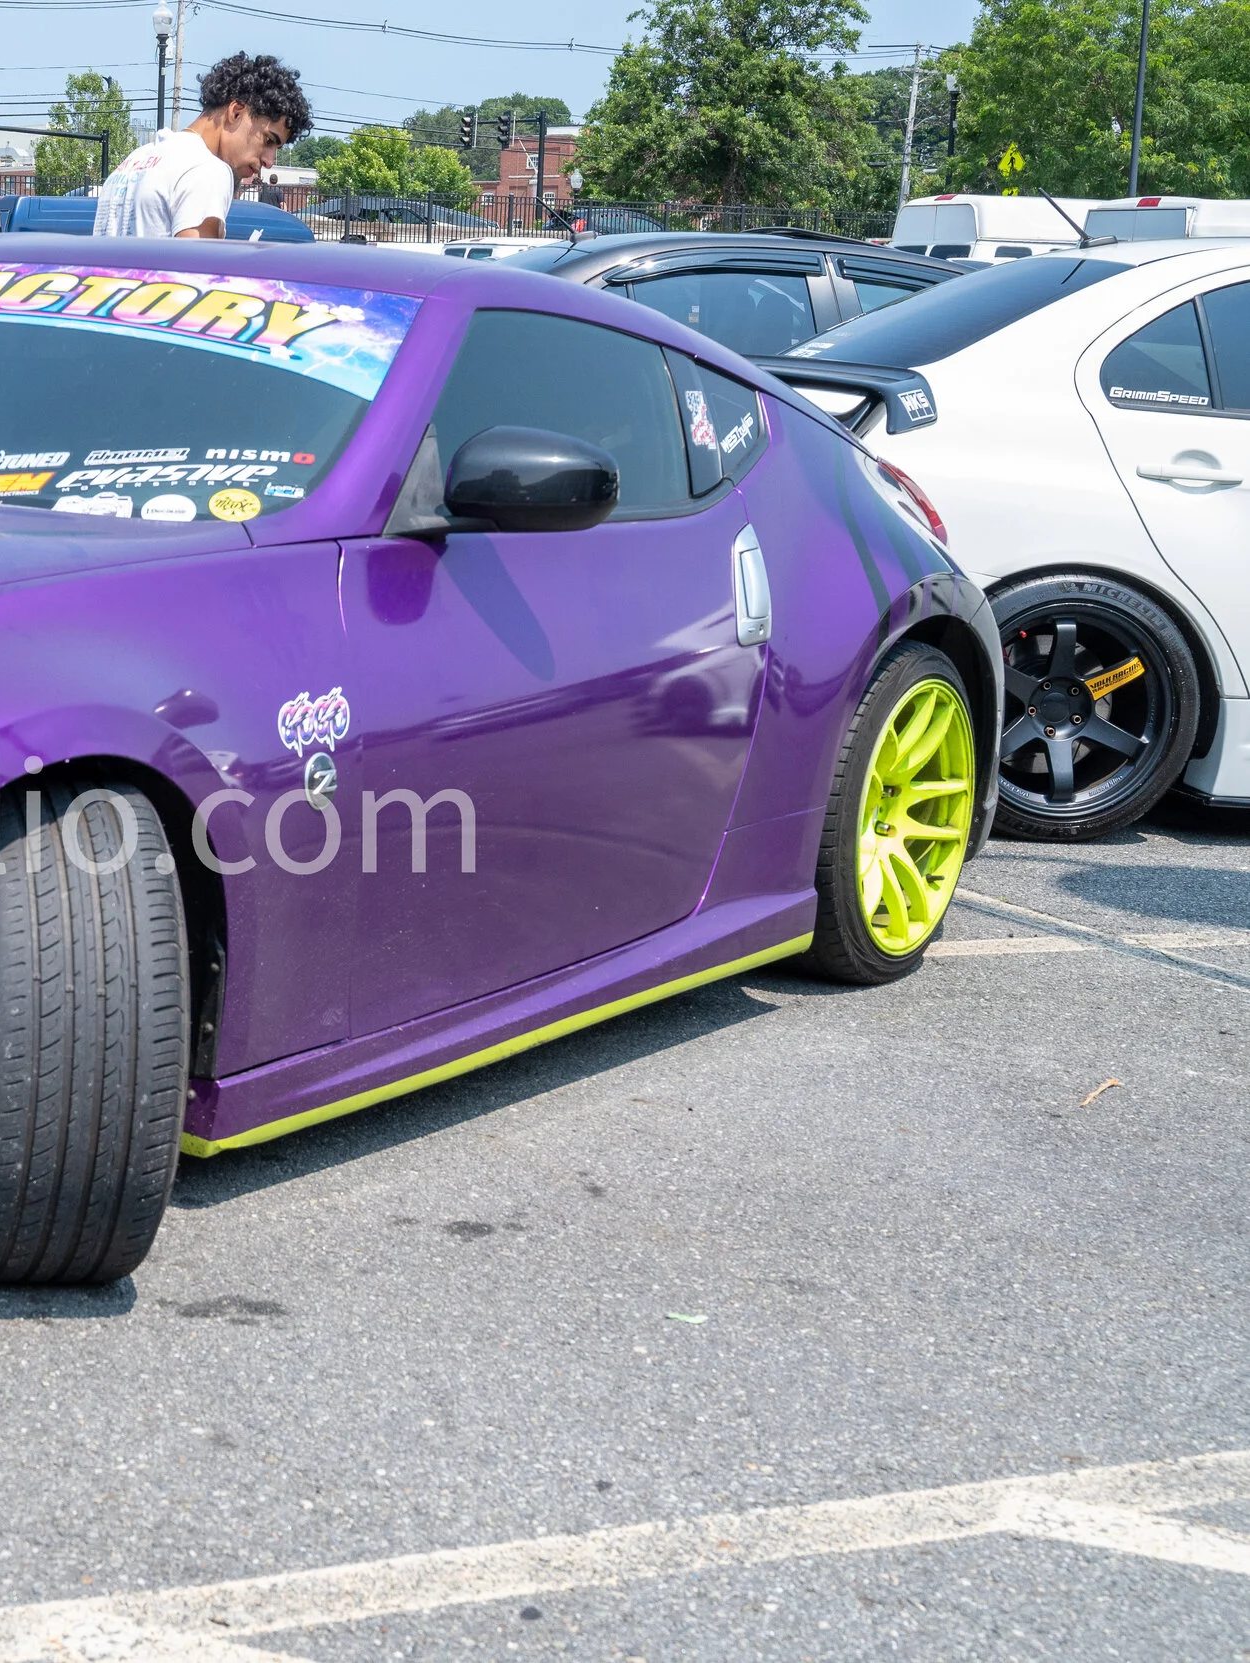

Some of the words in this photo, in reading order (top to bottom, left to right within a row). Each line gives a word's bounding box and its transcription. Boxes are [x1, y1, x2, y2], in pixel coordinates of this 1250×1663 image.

[899, 389, 932, 414] HKS
[205, 448, 316, 465] nismo
[1082, 583, 1168, 632] MICHELIN
